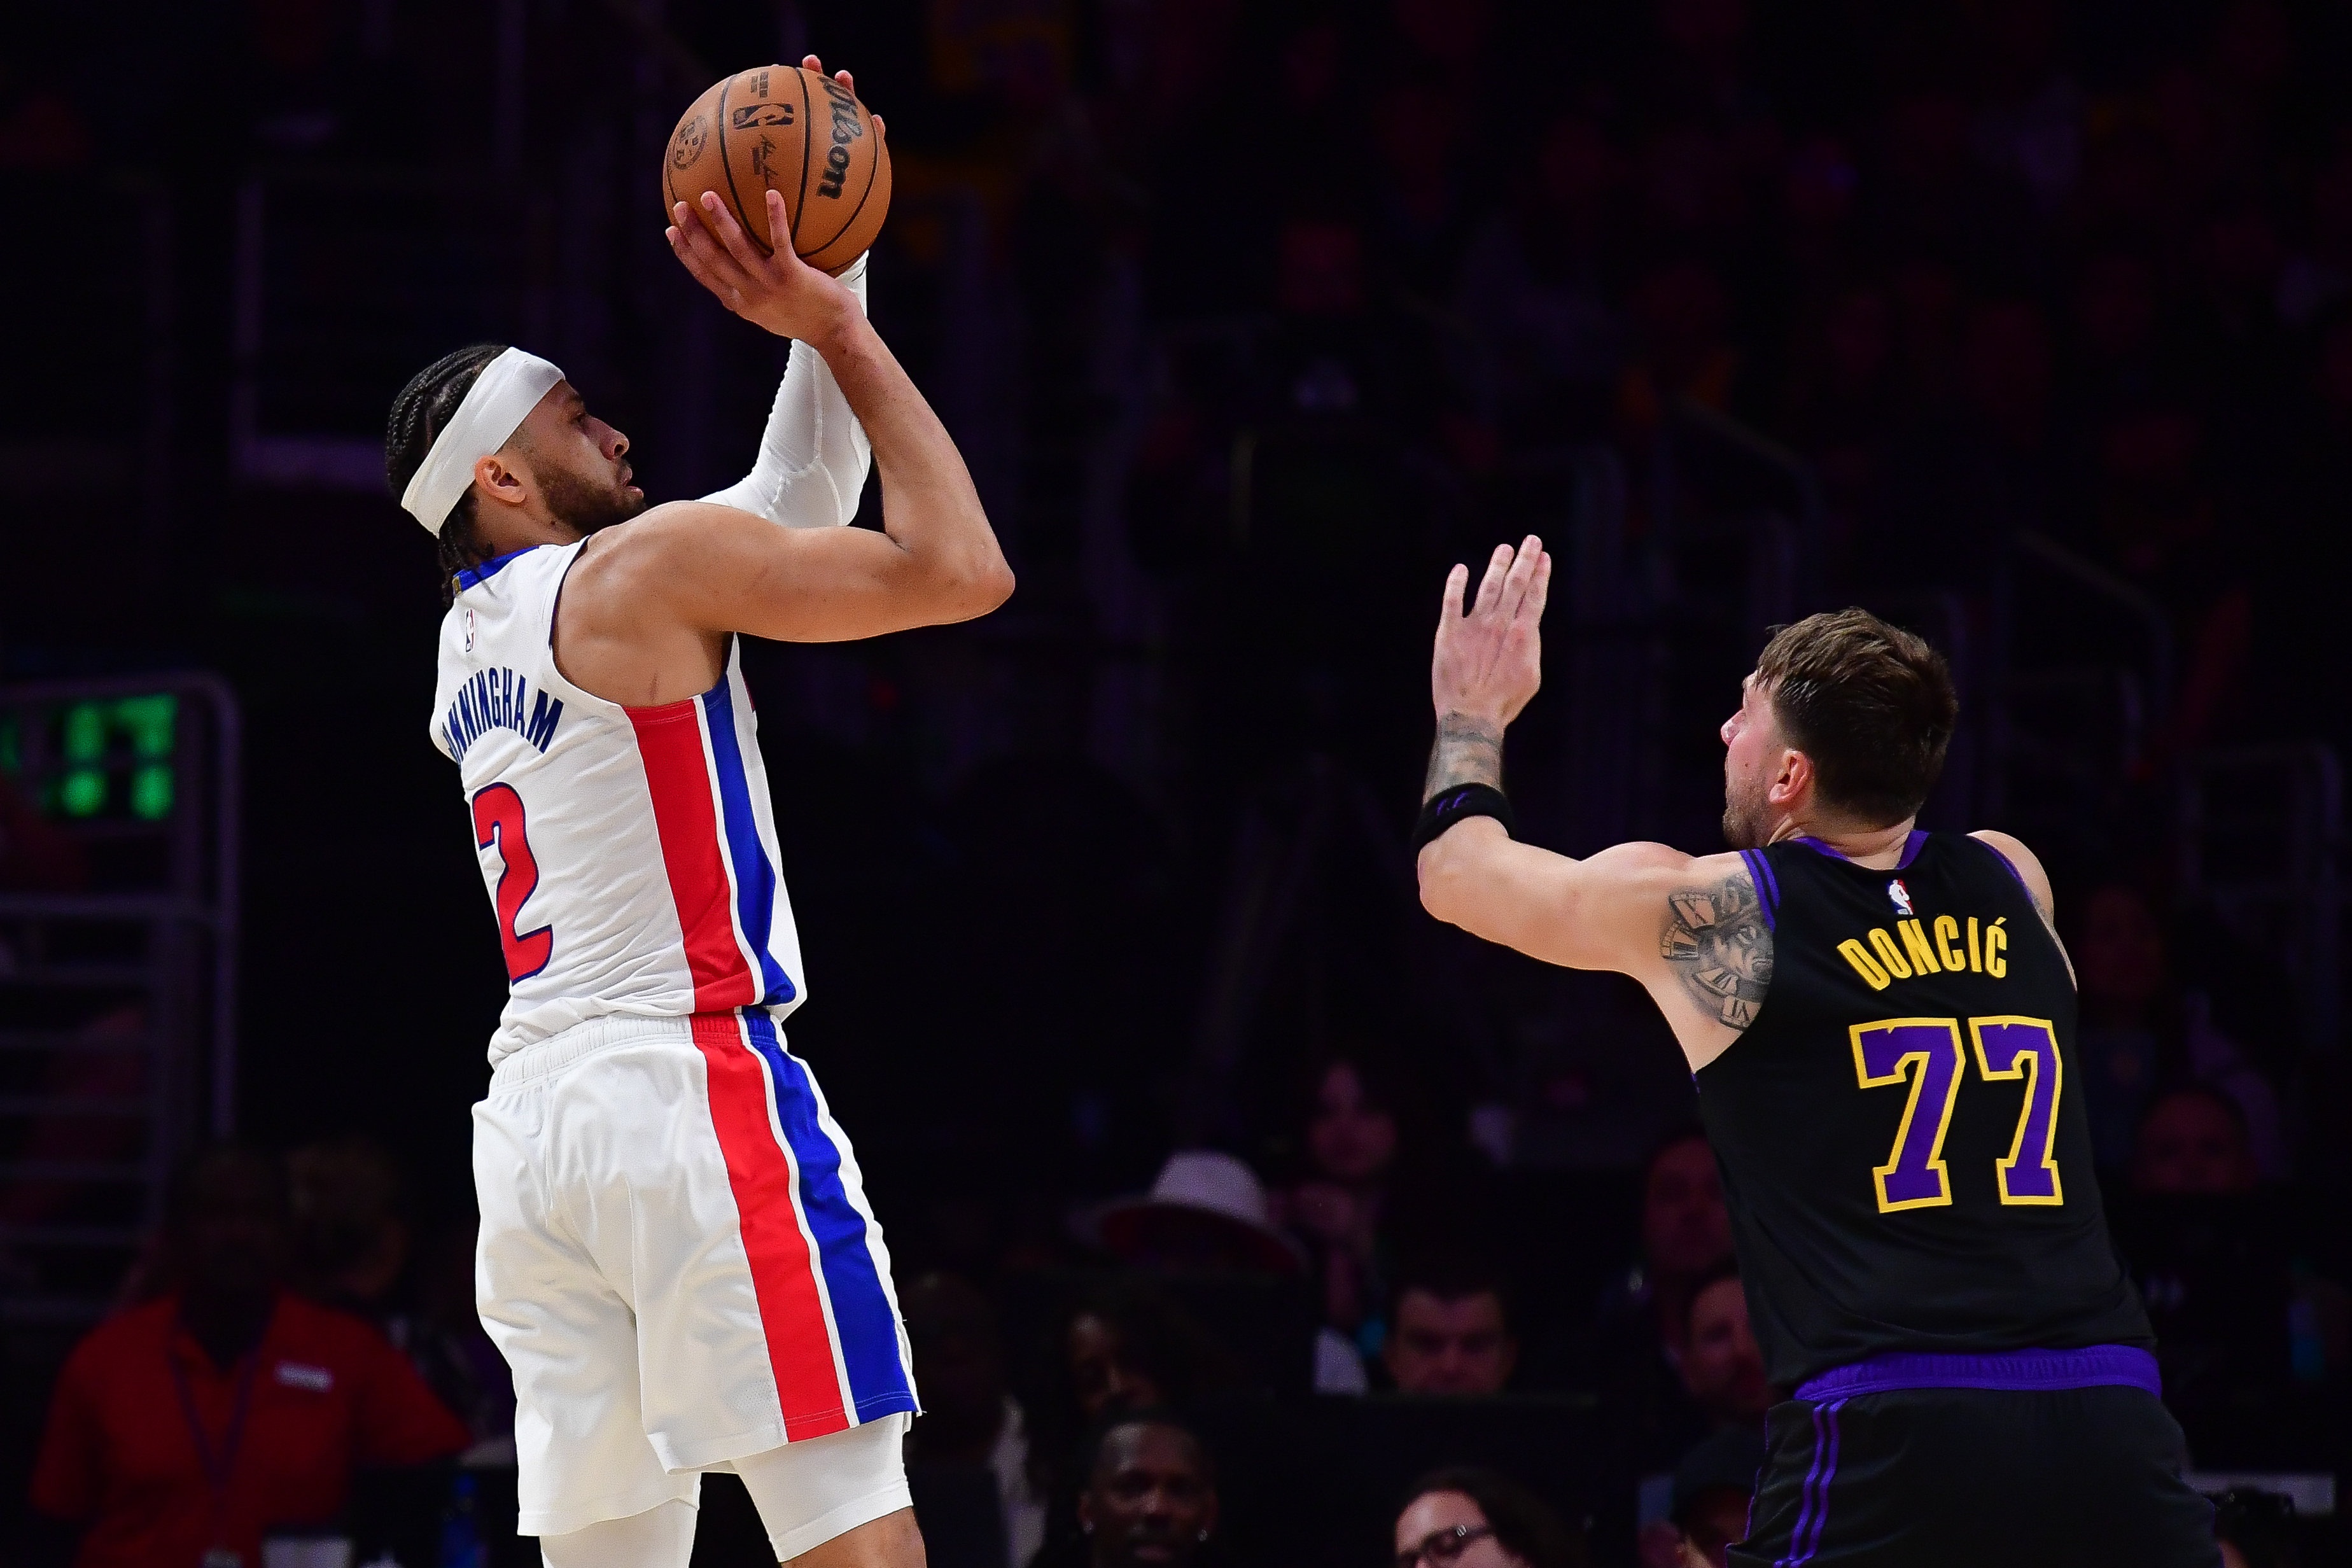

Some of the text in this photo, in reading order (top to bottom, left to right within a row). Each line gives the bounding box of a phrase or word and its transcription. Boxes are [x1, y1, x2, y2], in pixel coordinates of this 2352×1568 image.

[442, 666, 565, 771] UNNINGHAM
[472, 782, 554, 987] 2
[1848, 1015, 2064, 1214] 77
